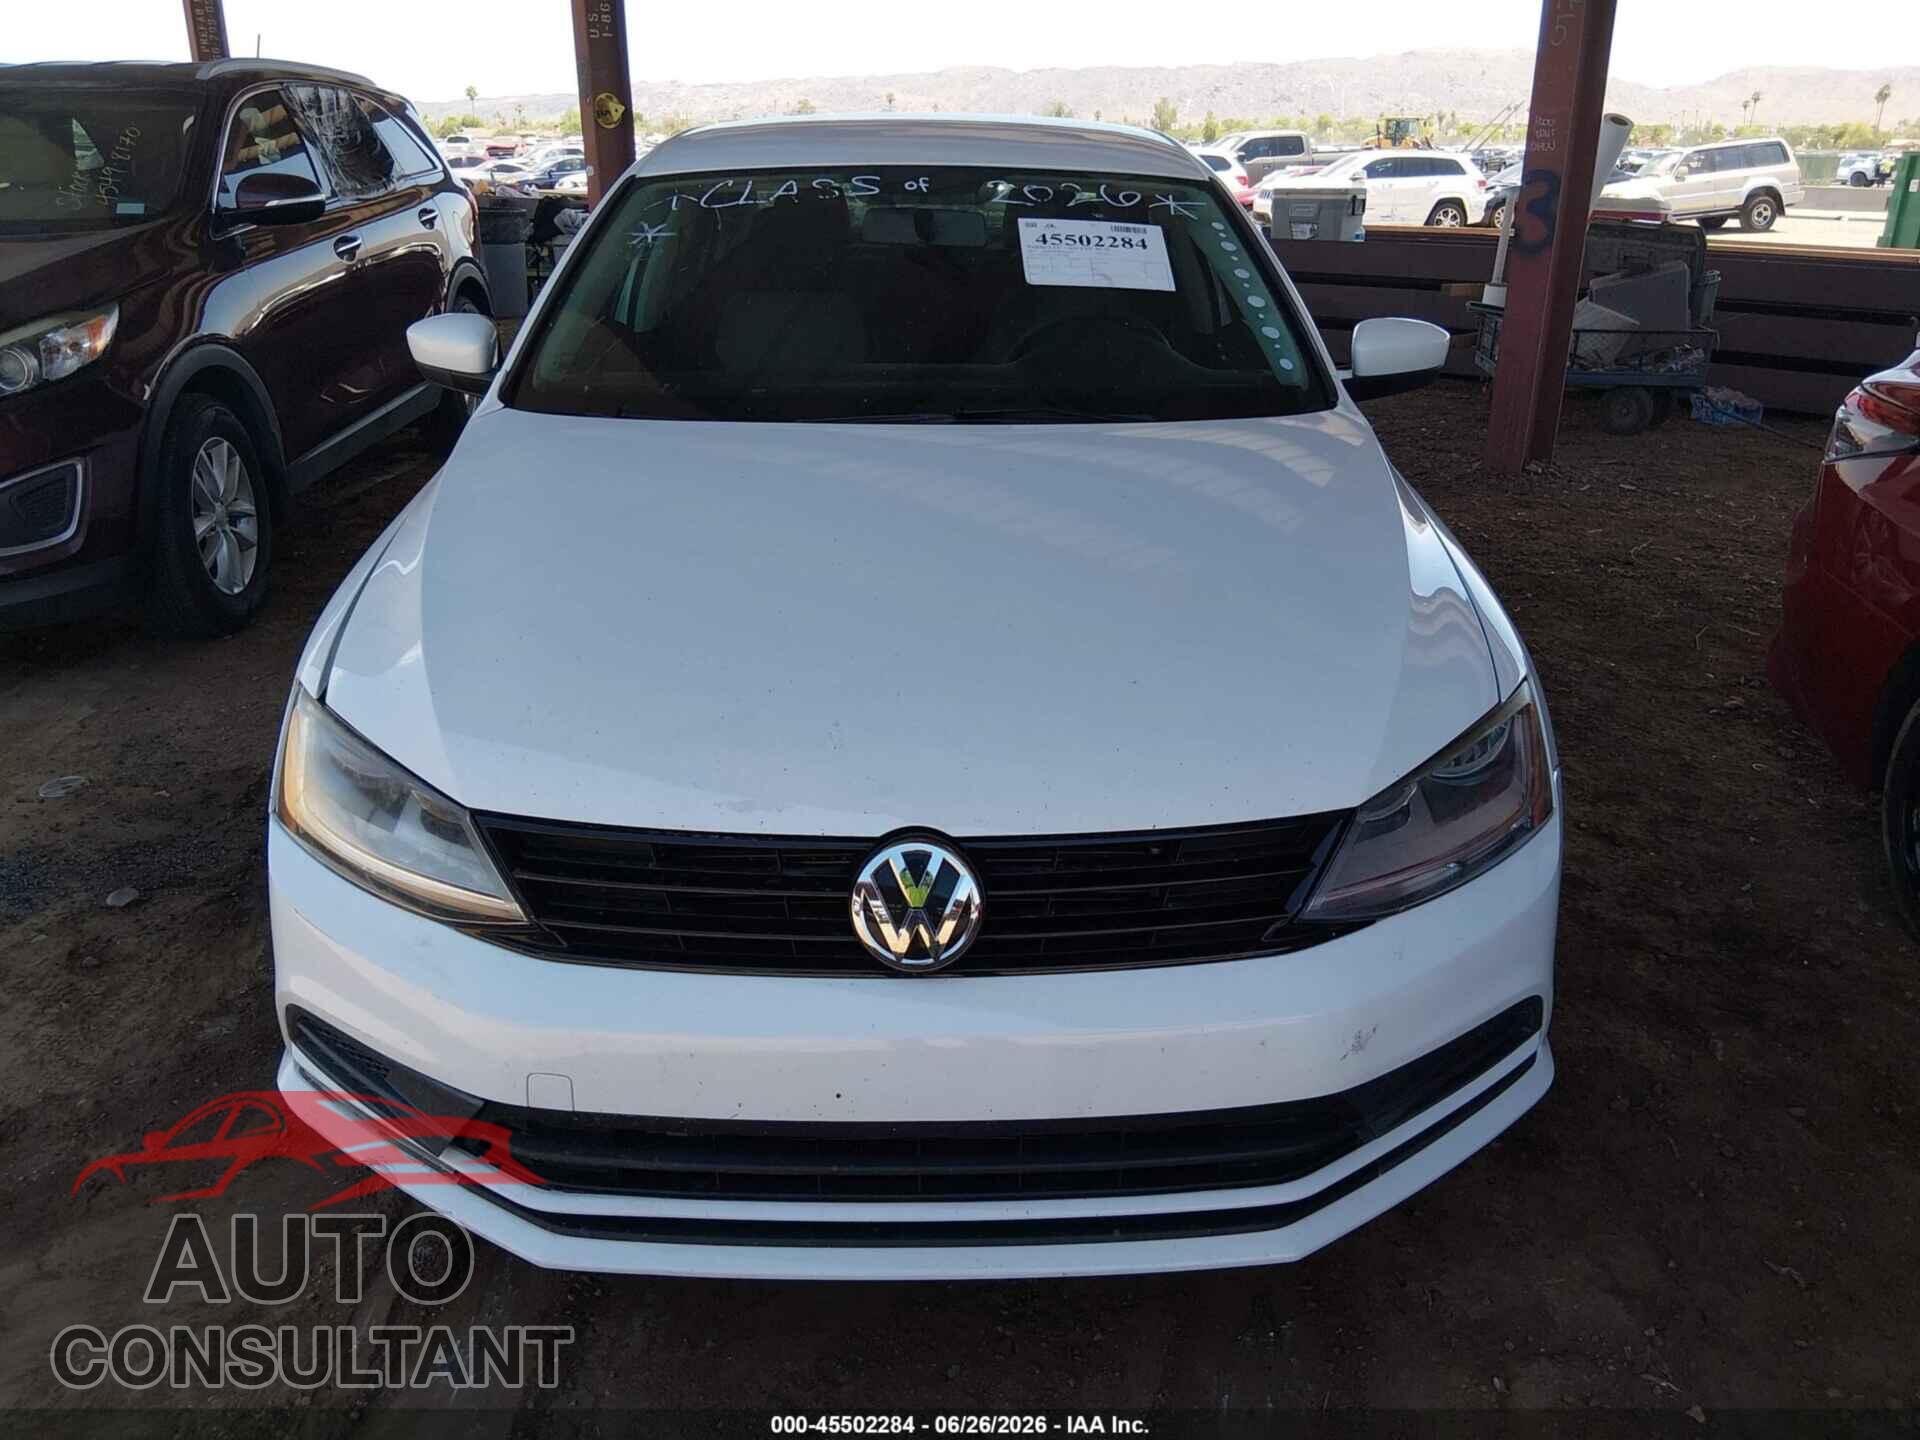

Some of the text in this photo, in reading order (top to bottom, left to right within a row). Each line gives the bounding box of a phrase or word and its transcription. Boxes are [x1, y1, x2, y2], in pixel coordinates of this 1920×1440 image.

[700, 175, 1142, 208] CLASS of 2026
[1515, 169, 1562, 256] 3
[1035, 233, 1148, 250] 45502284
